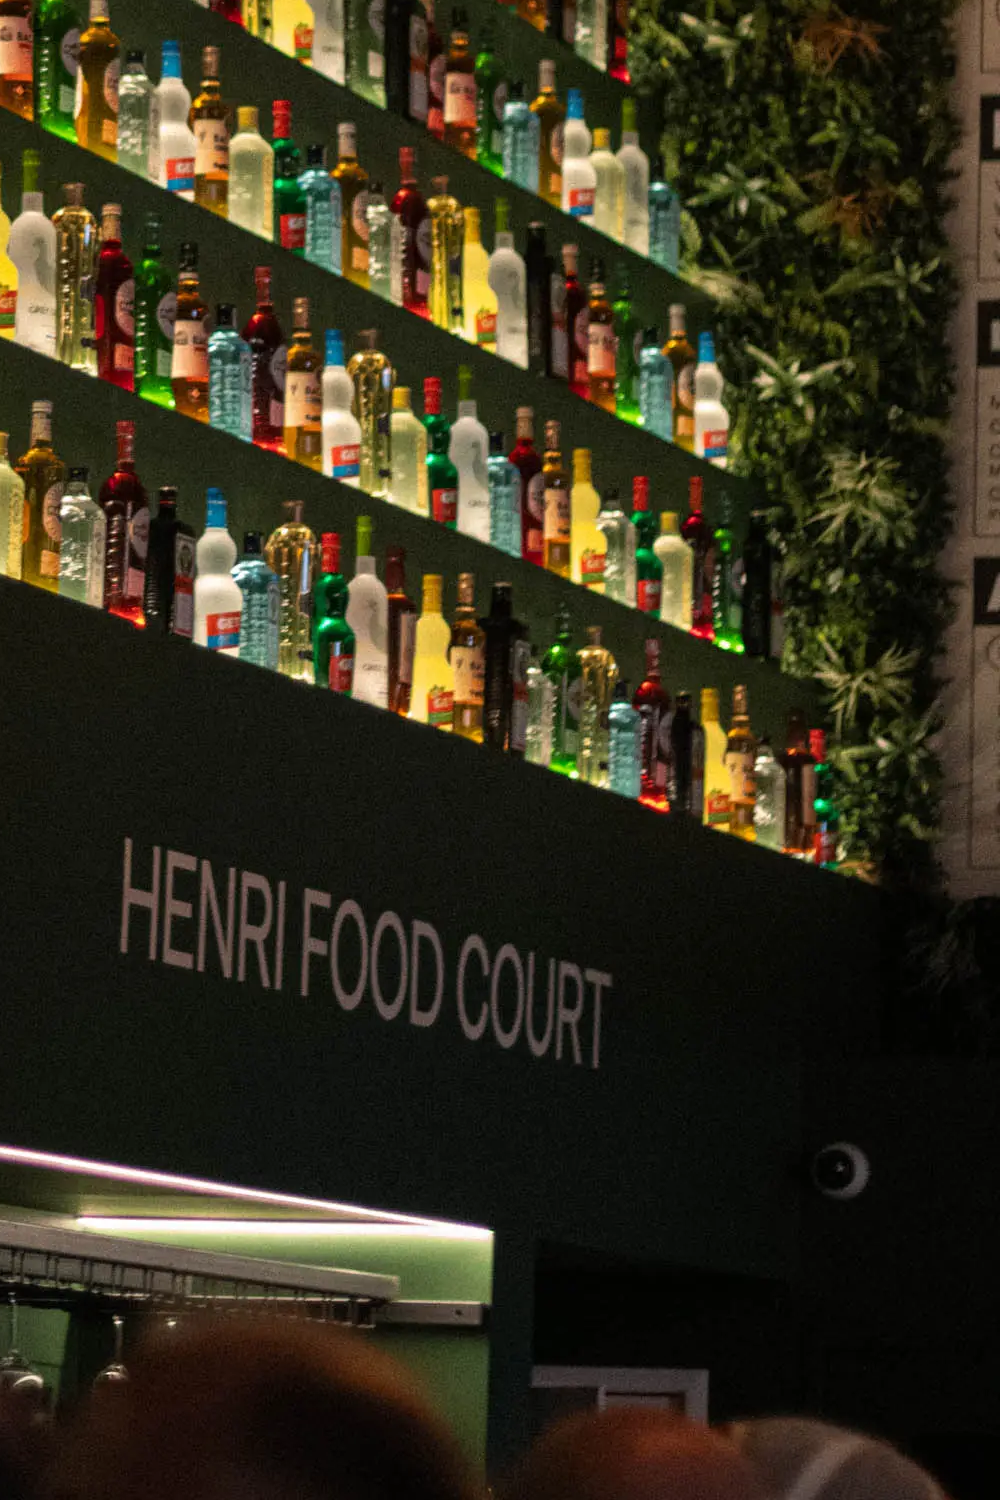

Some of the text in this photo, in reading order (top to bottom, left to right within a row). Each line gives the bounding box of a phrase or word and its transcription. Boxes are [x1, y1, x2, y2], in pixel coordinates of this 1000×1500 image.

[176, 161, 194, 174] GE
[119, 836, 613, 1070] HENRI FOOD COURT
